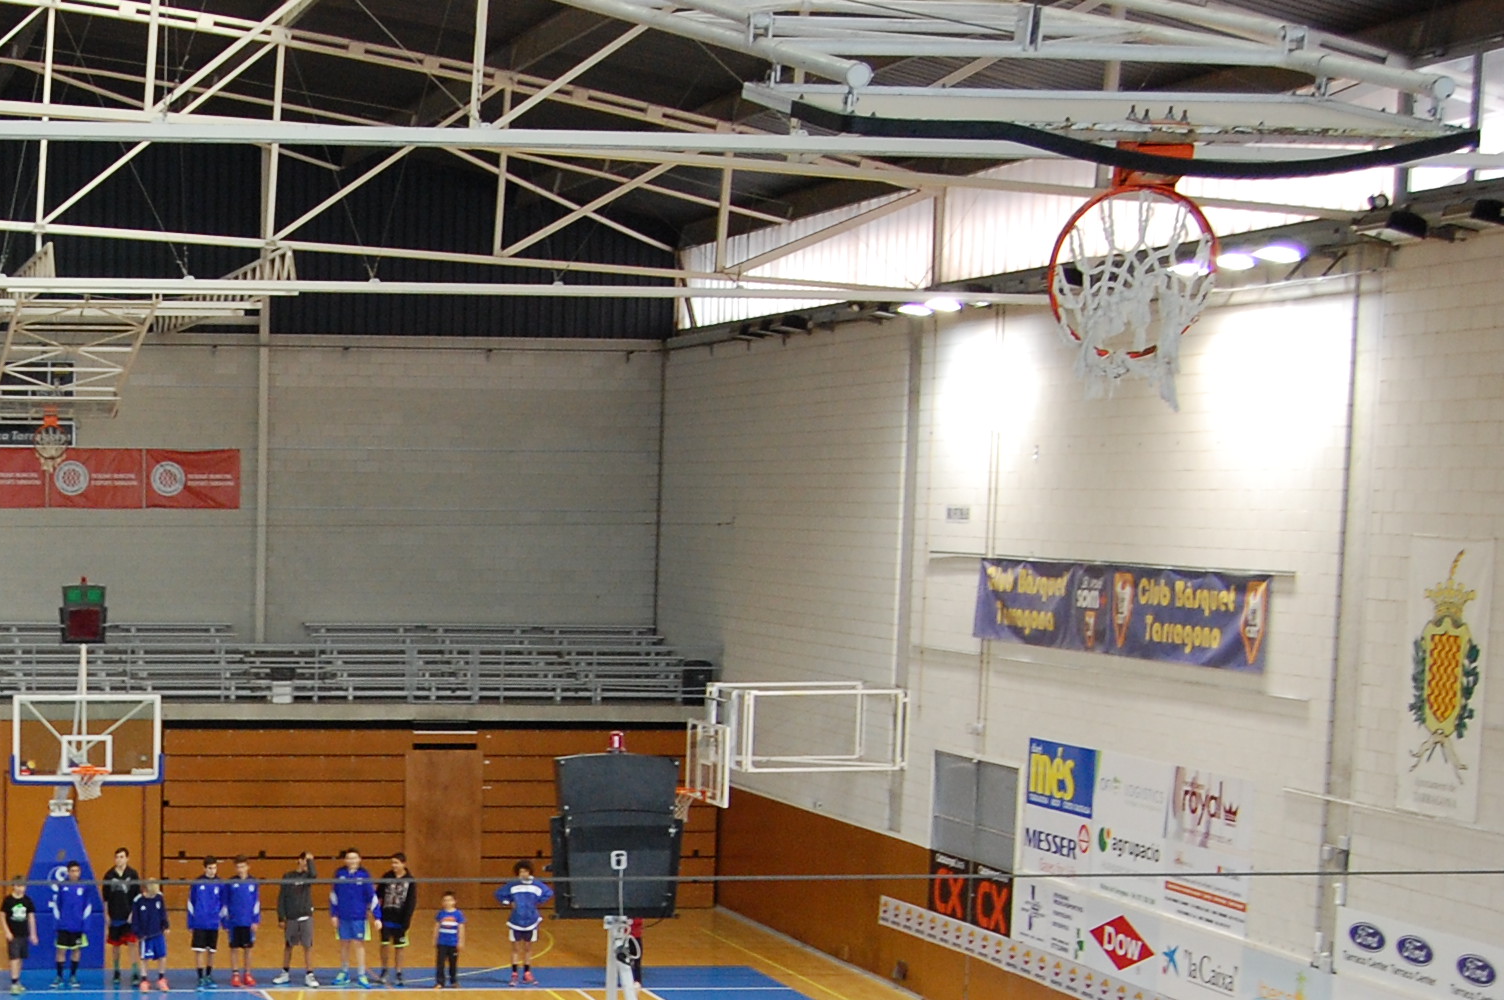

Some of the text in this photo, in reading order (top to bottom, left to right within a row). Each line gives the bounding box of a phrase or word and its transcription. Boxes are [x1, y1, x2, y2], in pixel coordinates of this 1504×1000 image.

[1138, 578, 1236, 616] Club Bàsquet
[1144, 615, 1222, 655] Tarragona
[1029, 747, 1075, 801] més
[1181, 781, 1223, 826] royal
[1025, 827, 1077, 860] MESSER
[933, 867, 966, 919] CX
[976, 881, 1009, 935] CX
[1102, 925, 1143, 961] DOW
